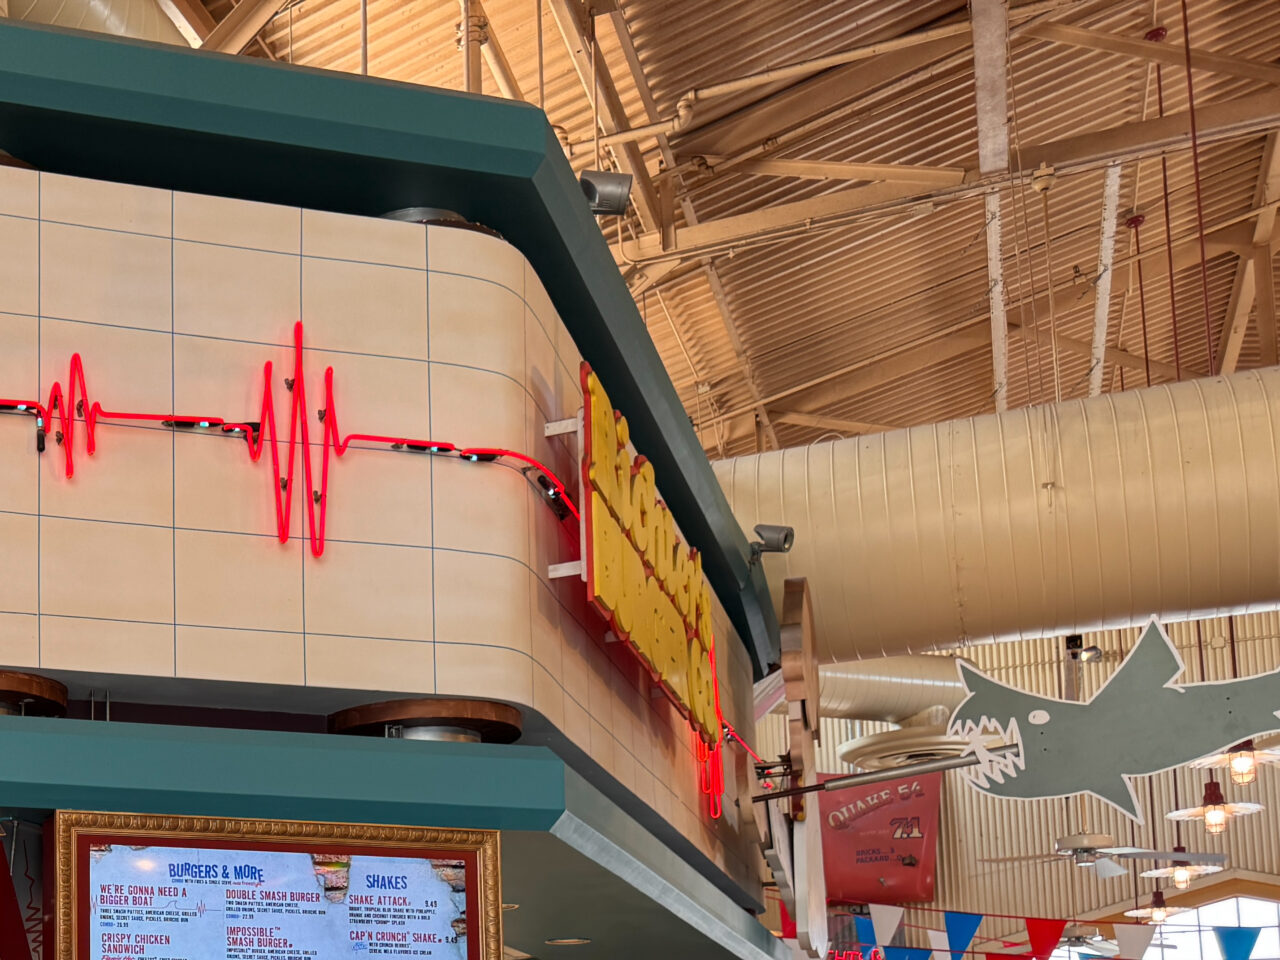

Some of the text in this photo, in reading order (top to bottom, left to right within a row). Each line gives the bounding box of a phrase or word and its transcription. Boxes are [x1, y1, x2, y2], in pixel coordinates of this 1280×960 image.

[828, 789, 891, 829] QUAKE
[168, 863, 265, 882] BURGERS & MORE
[366, 874, 407, 889] SHAKES
[100, 884, 187, 897] WE'RE GONNA NEED A
[225, 889, 320, 902] DOUBLE SMASH BURGER
[100, 895, 154, 906] BIGGER BOAT
[349, 894, 374, 905] SHAKE
[377, 895, 408, 906] ATTACK
[101, 933, 170, 945] CRISPY CHICKEN
[350, 931, 373, 941] CAP'N
[412, 932, 437, 943] SHAKE
[101, 944, 145, 954] SANDWICH
[226, 938, 288, 949] SMASH BURGER
